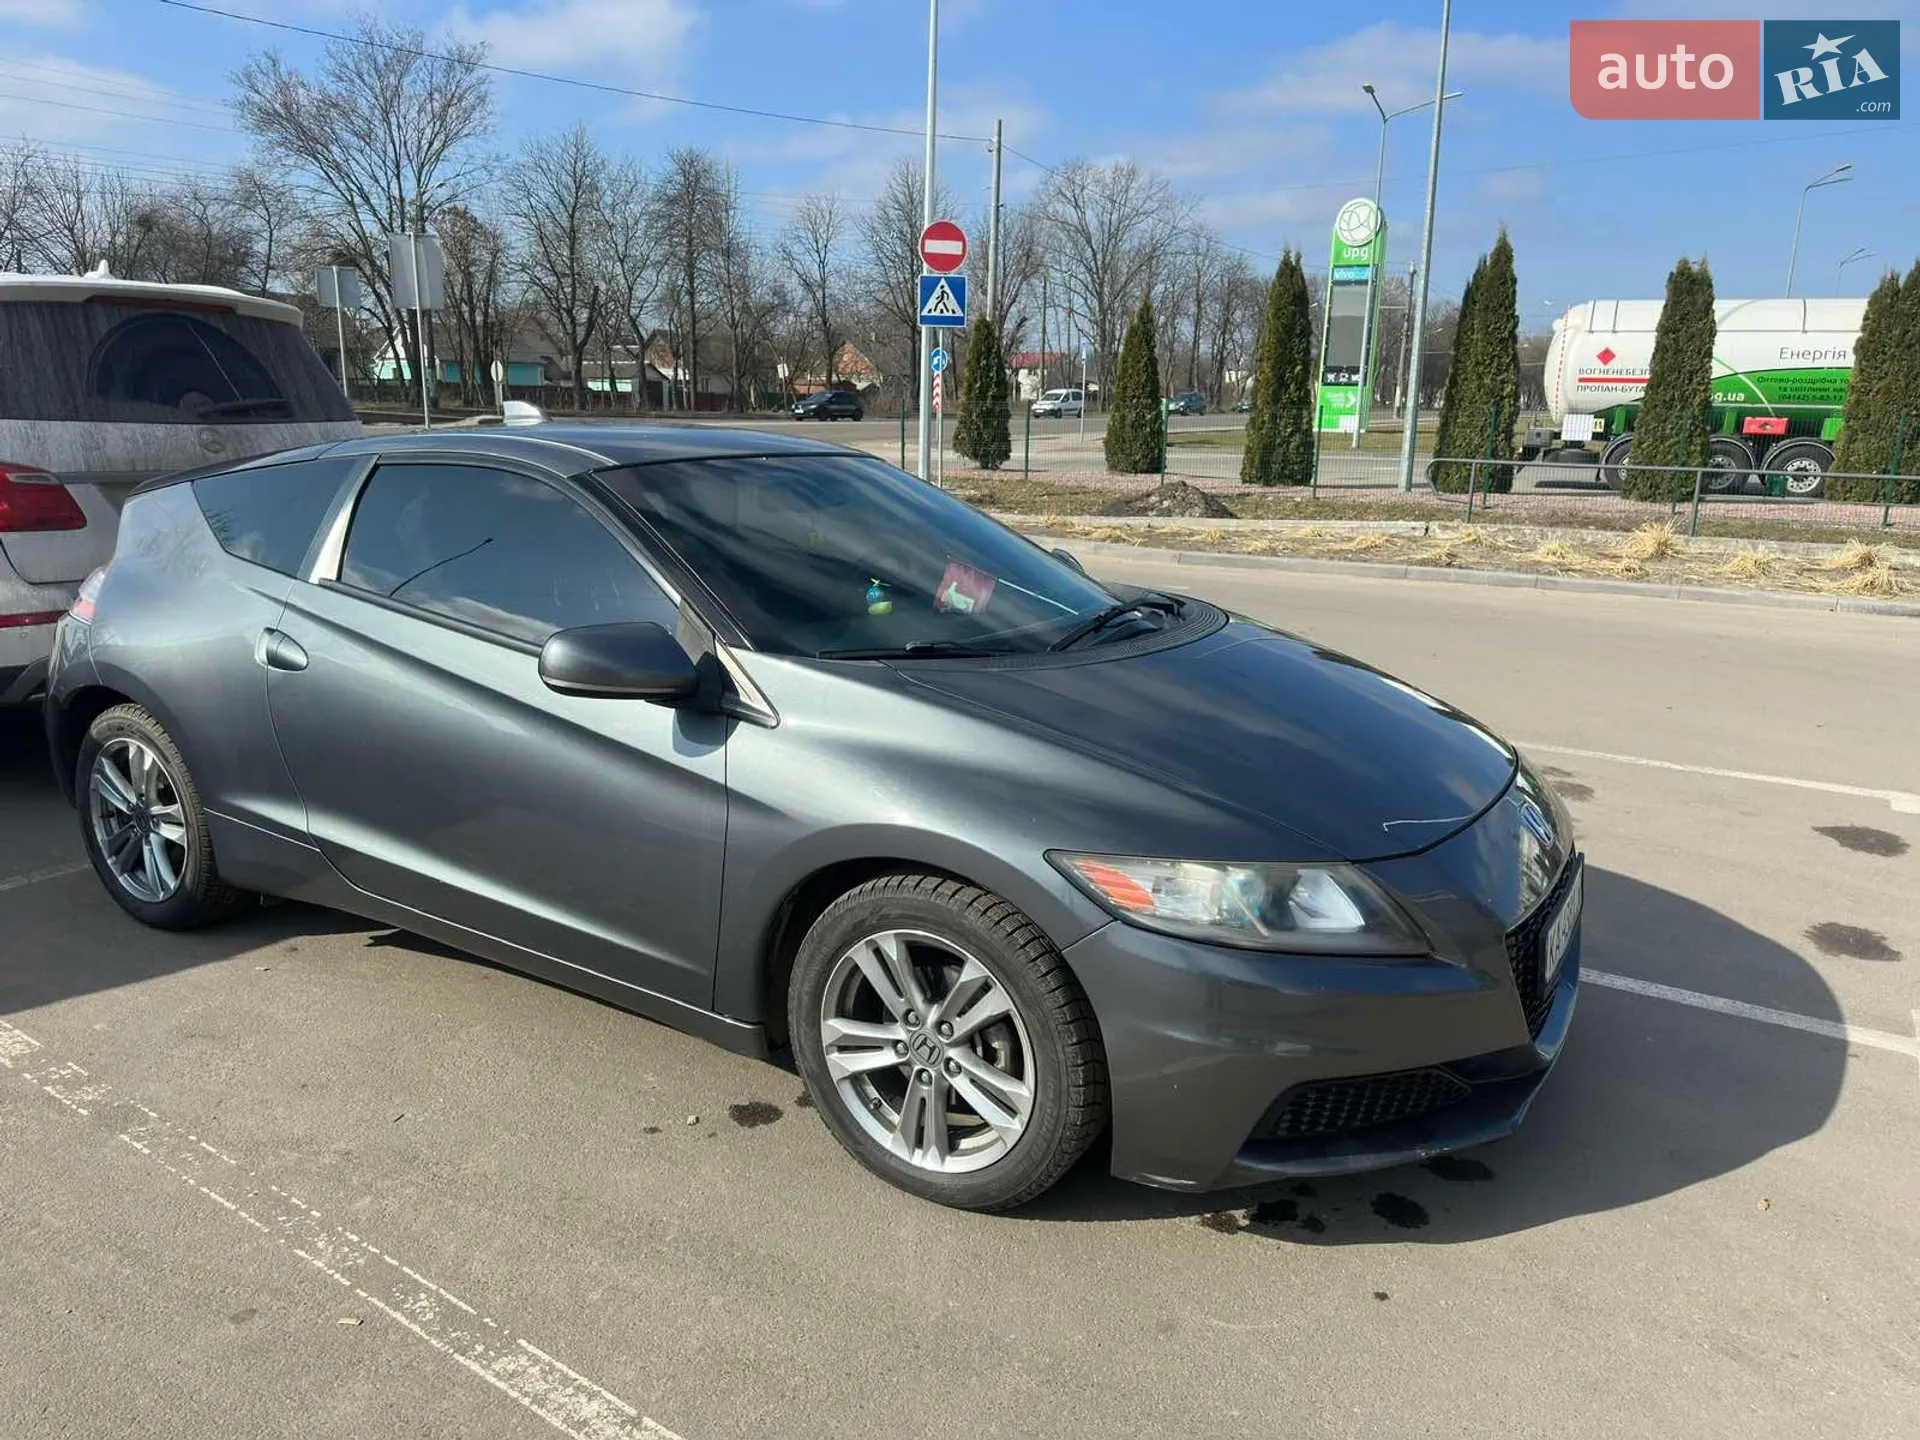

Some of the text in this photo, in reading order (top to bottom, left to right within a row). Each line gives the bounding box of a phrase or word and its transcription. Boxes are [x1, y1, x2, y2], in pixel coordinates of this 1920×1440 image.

[1343, 247, 1369, 261] upg
[1779, 346, 1847, 363] Енергія
[1710, 392, 1745, 404] g.ua
